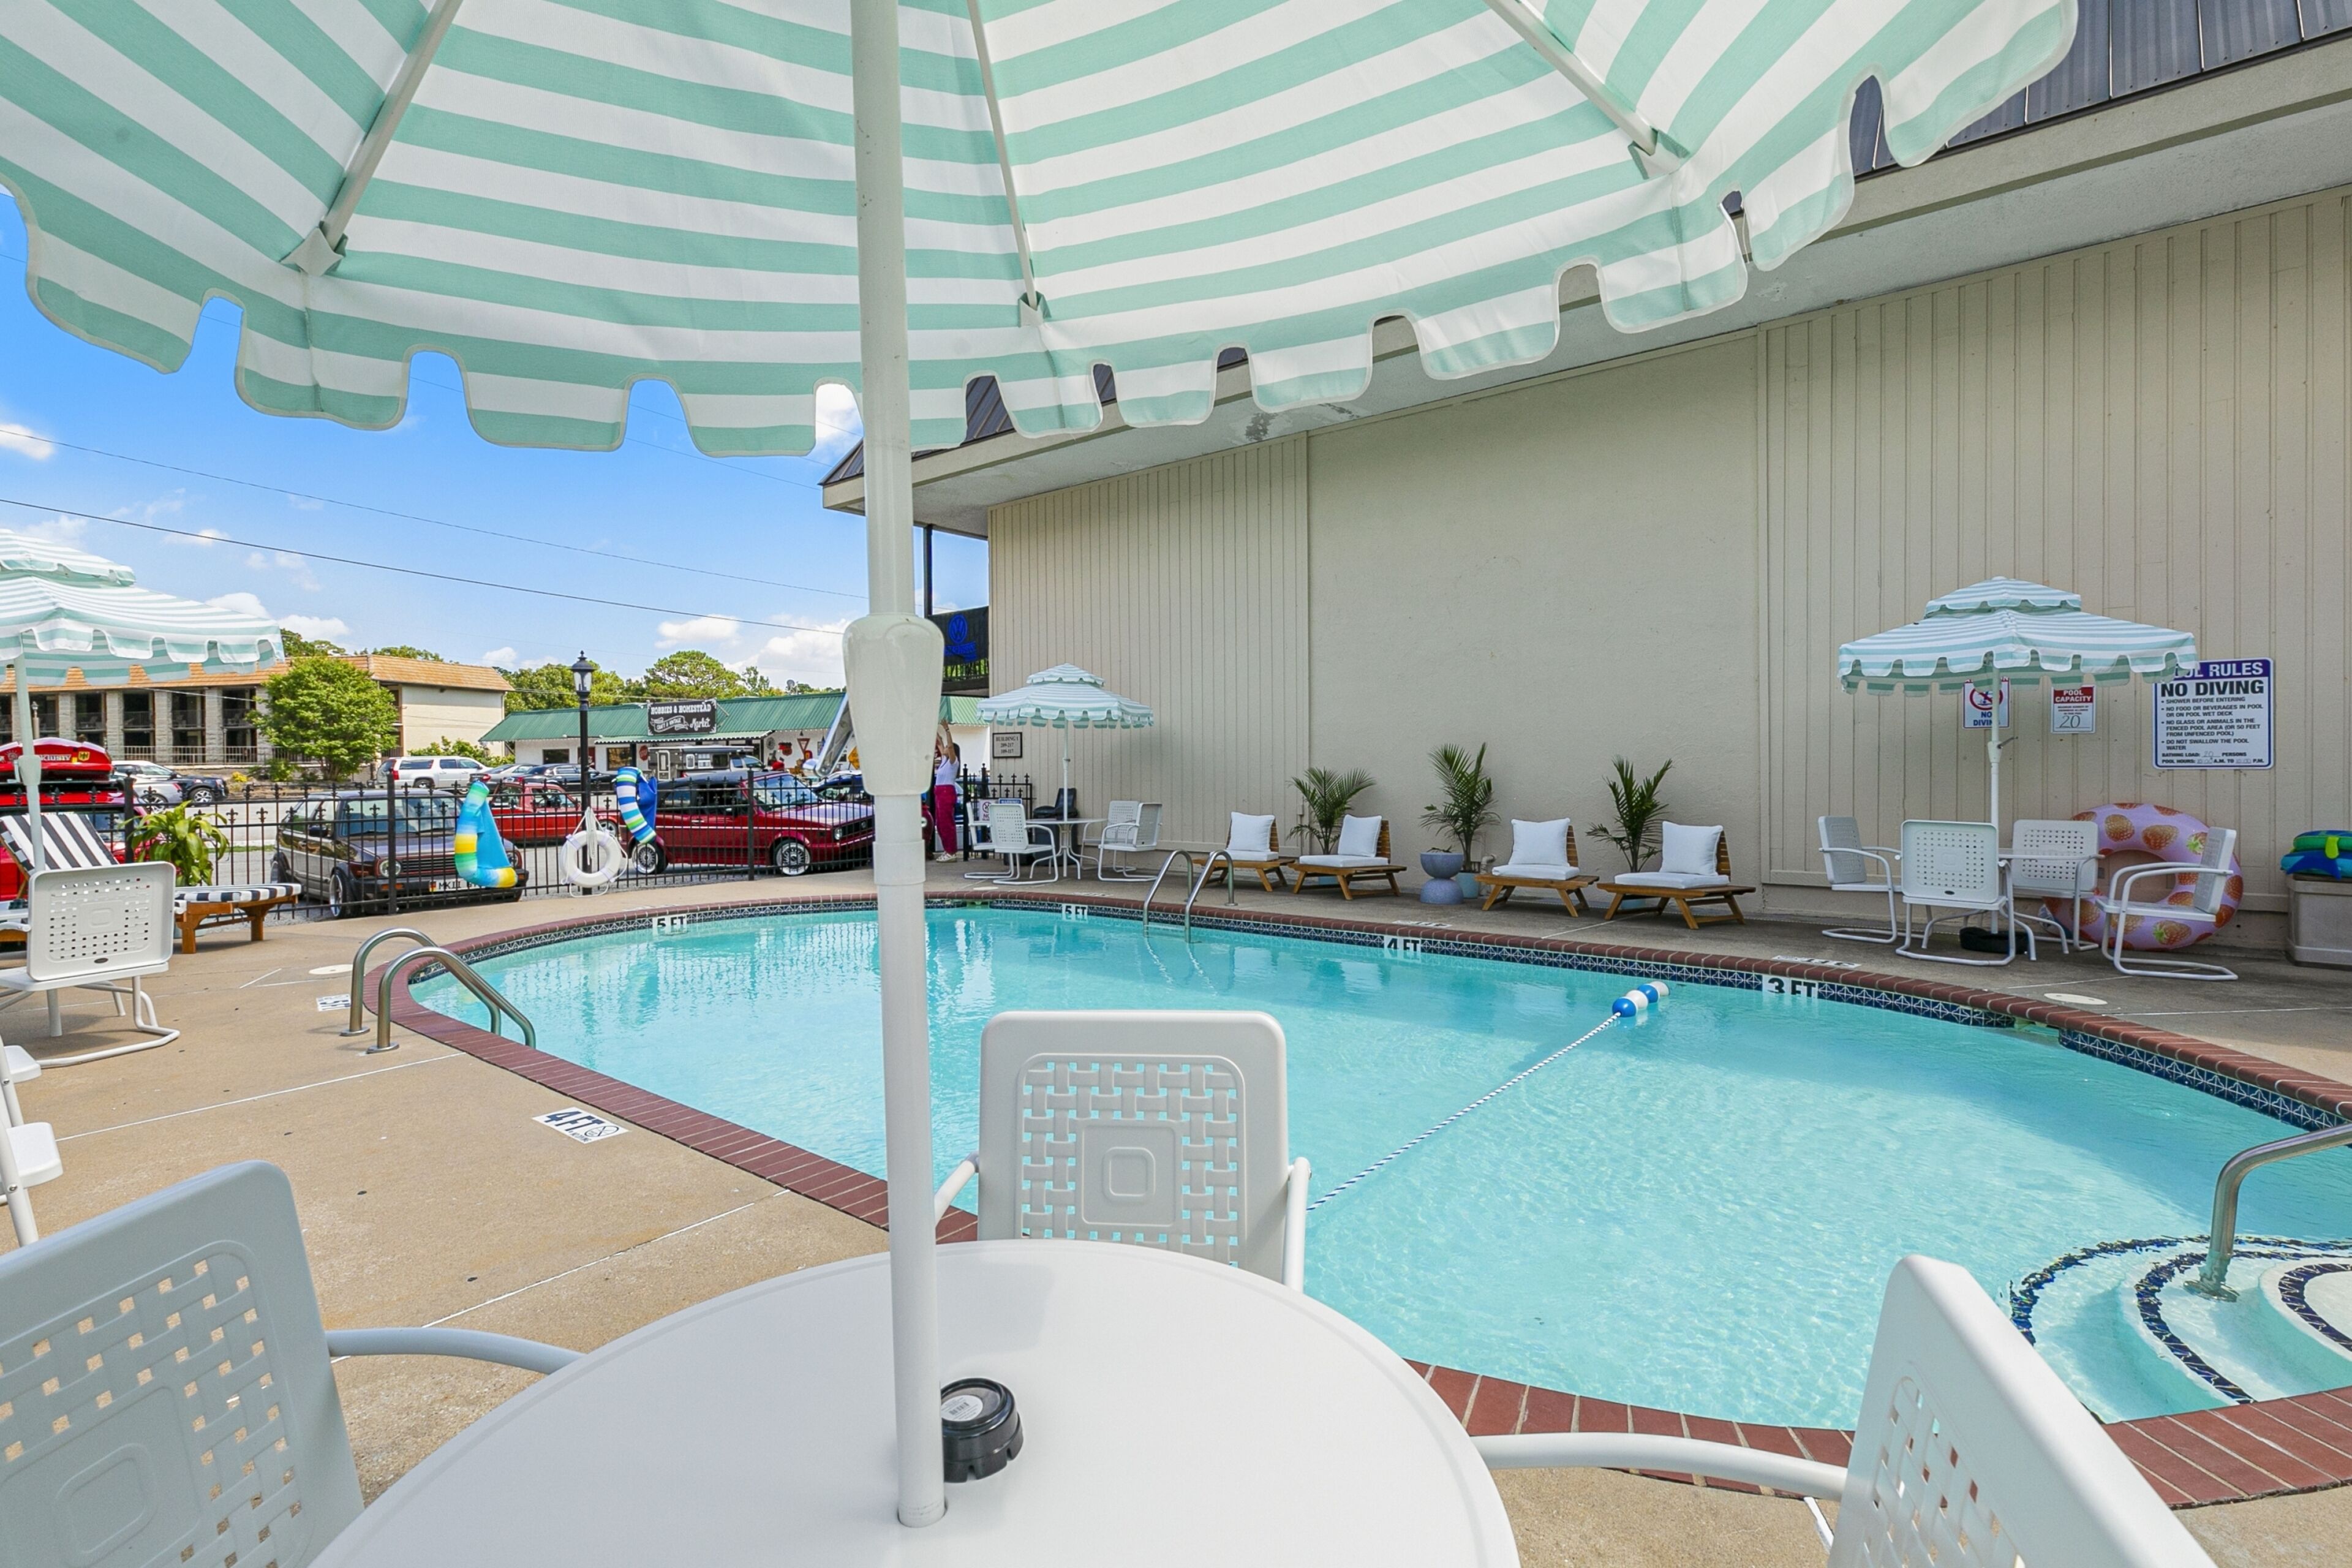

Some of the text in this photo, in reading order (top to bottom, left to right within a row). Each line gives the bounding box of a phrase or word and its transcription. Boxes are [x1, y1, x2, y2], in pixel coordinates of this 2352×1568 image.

[2209, 662, 2264, 677] RULES
[2161, 679, 2264, 697] NO DIVING
[650, 706, 673, 715] HOBBIES
[678, 703, 711, 714] HOMESTEAD
[690, 717, 710, 731] Market
[2059, 715, 2081, 728] 20
[1065, 905, 1087, 915] 5 FT
[657, 916, 686, 927] 5 FT
[1387, 938, 1420, 952] 4 FT
[1768, 978, 1816, 997] 3 FT
